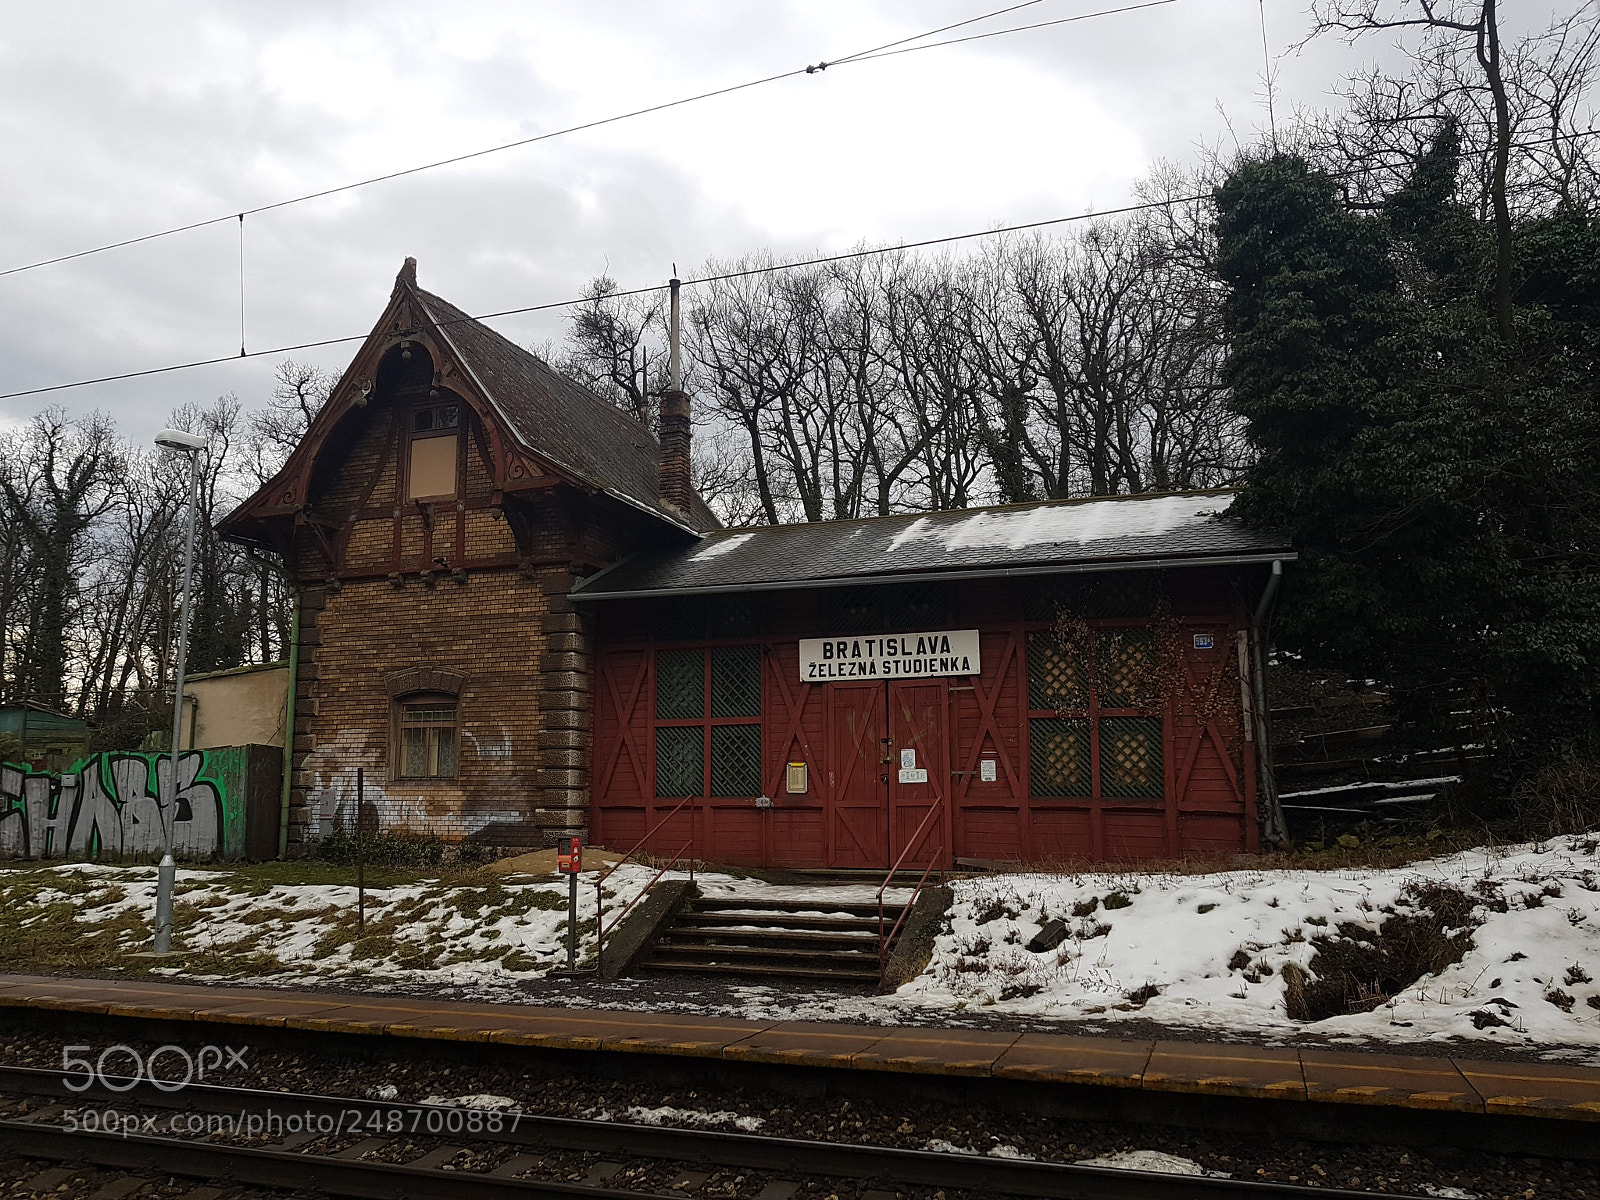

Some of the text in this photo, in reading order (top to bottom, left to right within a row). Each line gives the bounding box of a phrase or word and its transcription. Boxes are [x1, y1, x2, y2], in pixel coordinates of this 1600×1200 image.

[822, 635, 951, 660] BRATISLAVA
[808, 656, 971, 678] ŽELEZNÁ STUDIENKA
